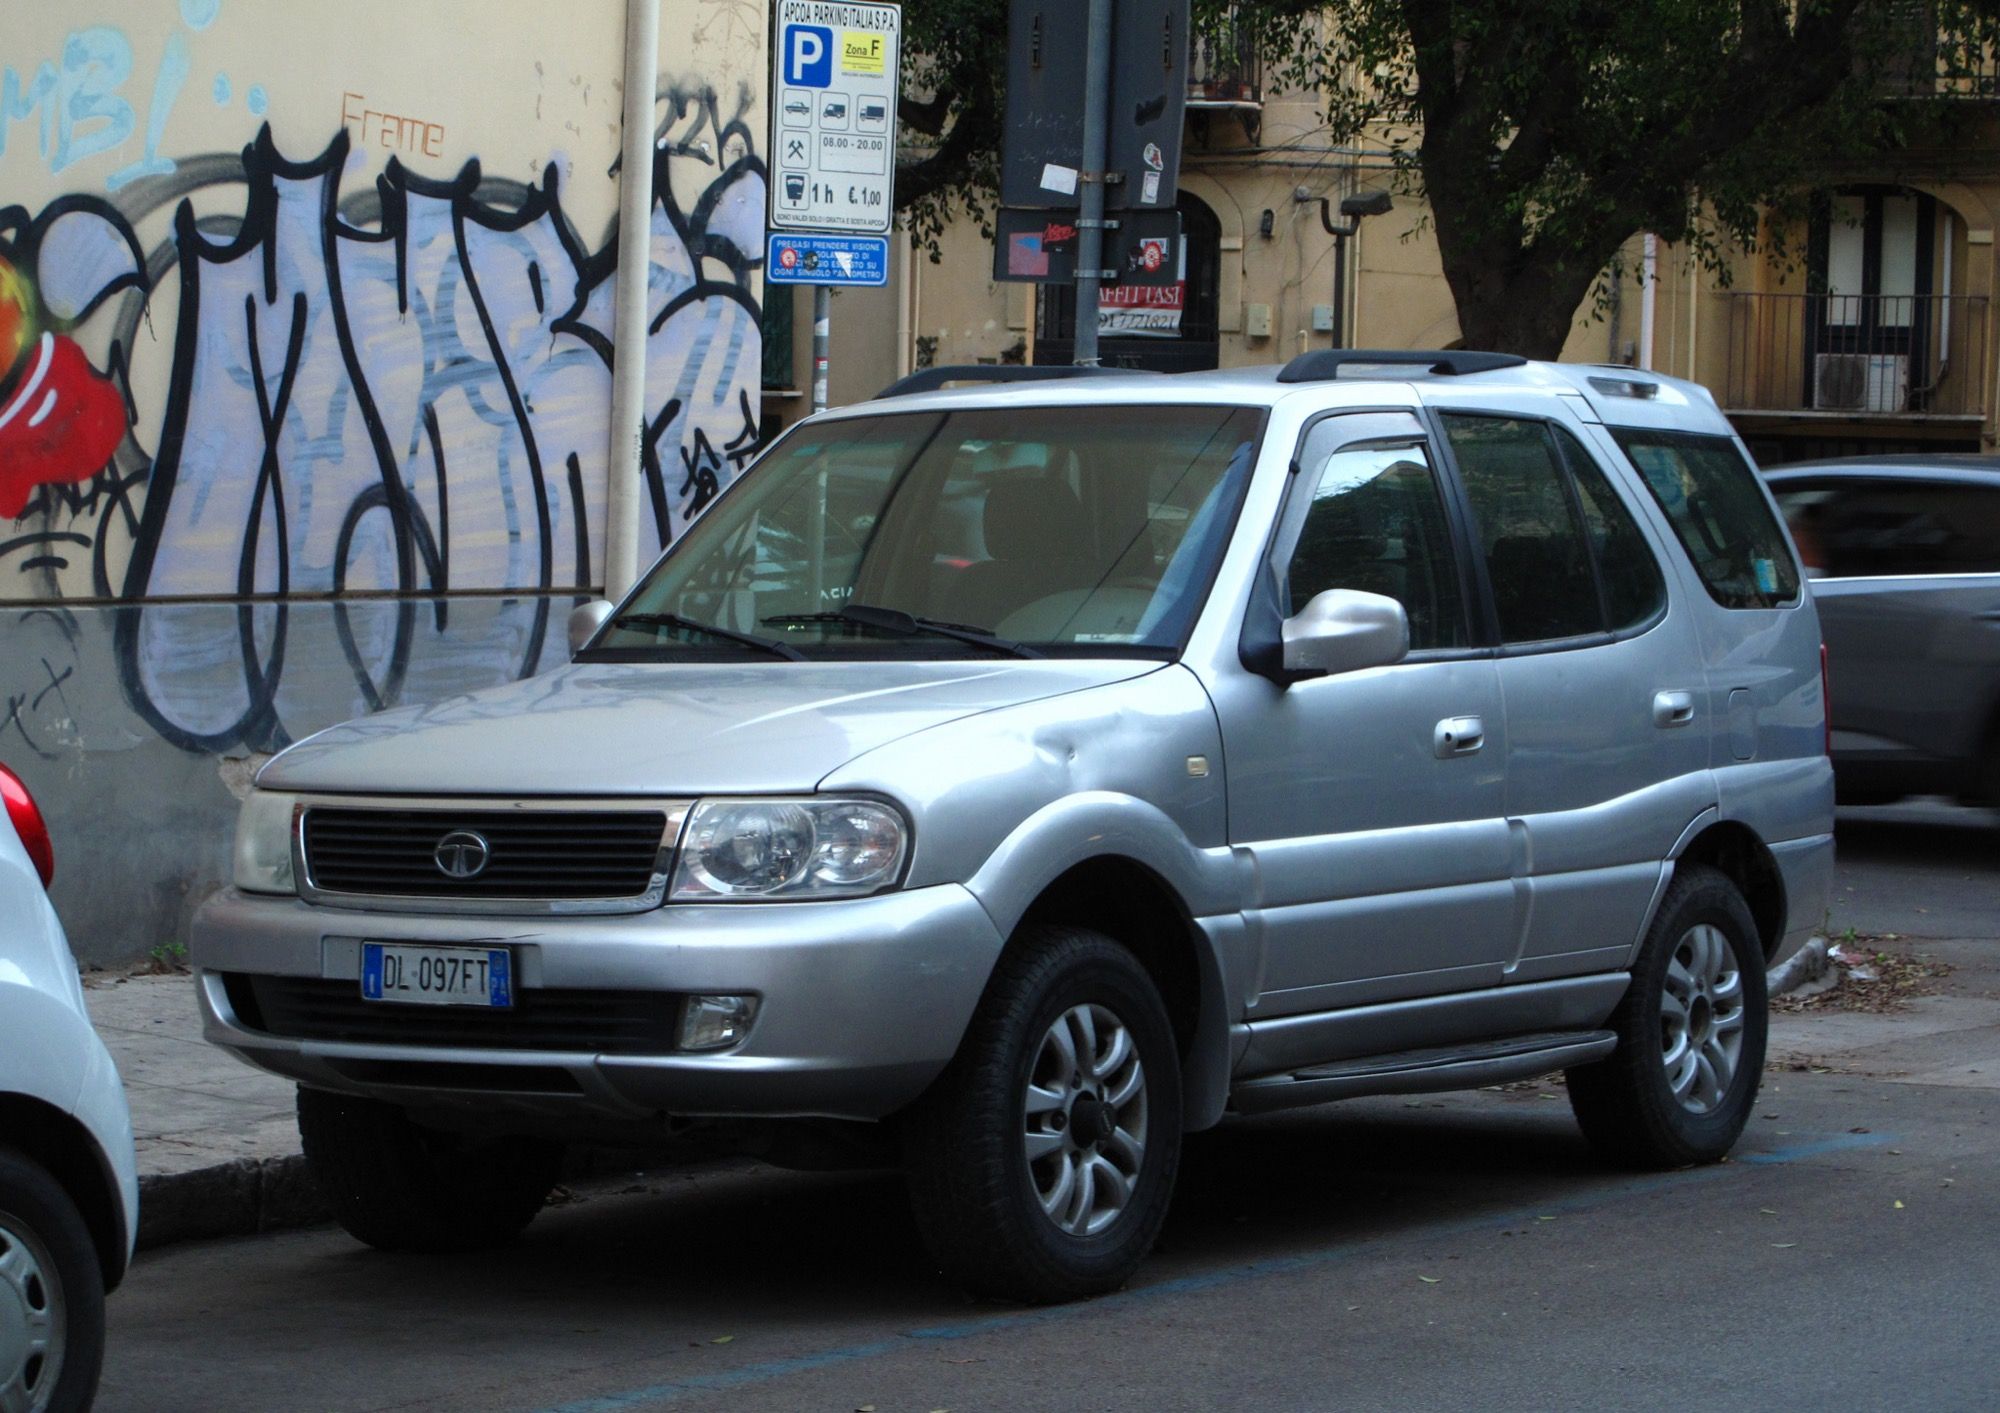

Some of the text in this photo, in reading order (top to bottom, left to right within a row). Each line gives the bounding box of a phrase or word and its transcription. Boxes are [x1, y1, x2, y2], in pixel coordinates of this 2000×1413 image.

[784, 2, 896, 32] APCOA PARKING ITALIA S.P.A.
[792, 30, 824, 80] P
[845, 39, 880, 56] Zona F
[341, 90, 444, 157] Frame
[823, 136, 848, 148] 08.00
[857, 139, 883, 151] 20.00
[812, 183, 818, 203] 1
[825, 184, 833, 204] h
[862, 187, 881, 207] 1,00
[776, 239, 880, 251] PREGASI PRENDERE VISIONE
[383, 954, 409, 990] DL
[419, 956, 488, 994] 097FT
